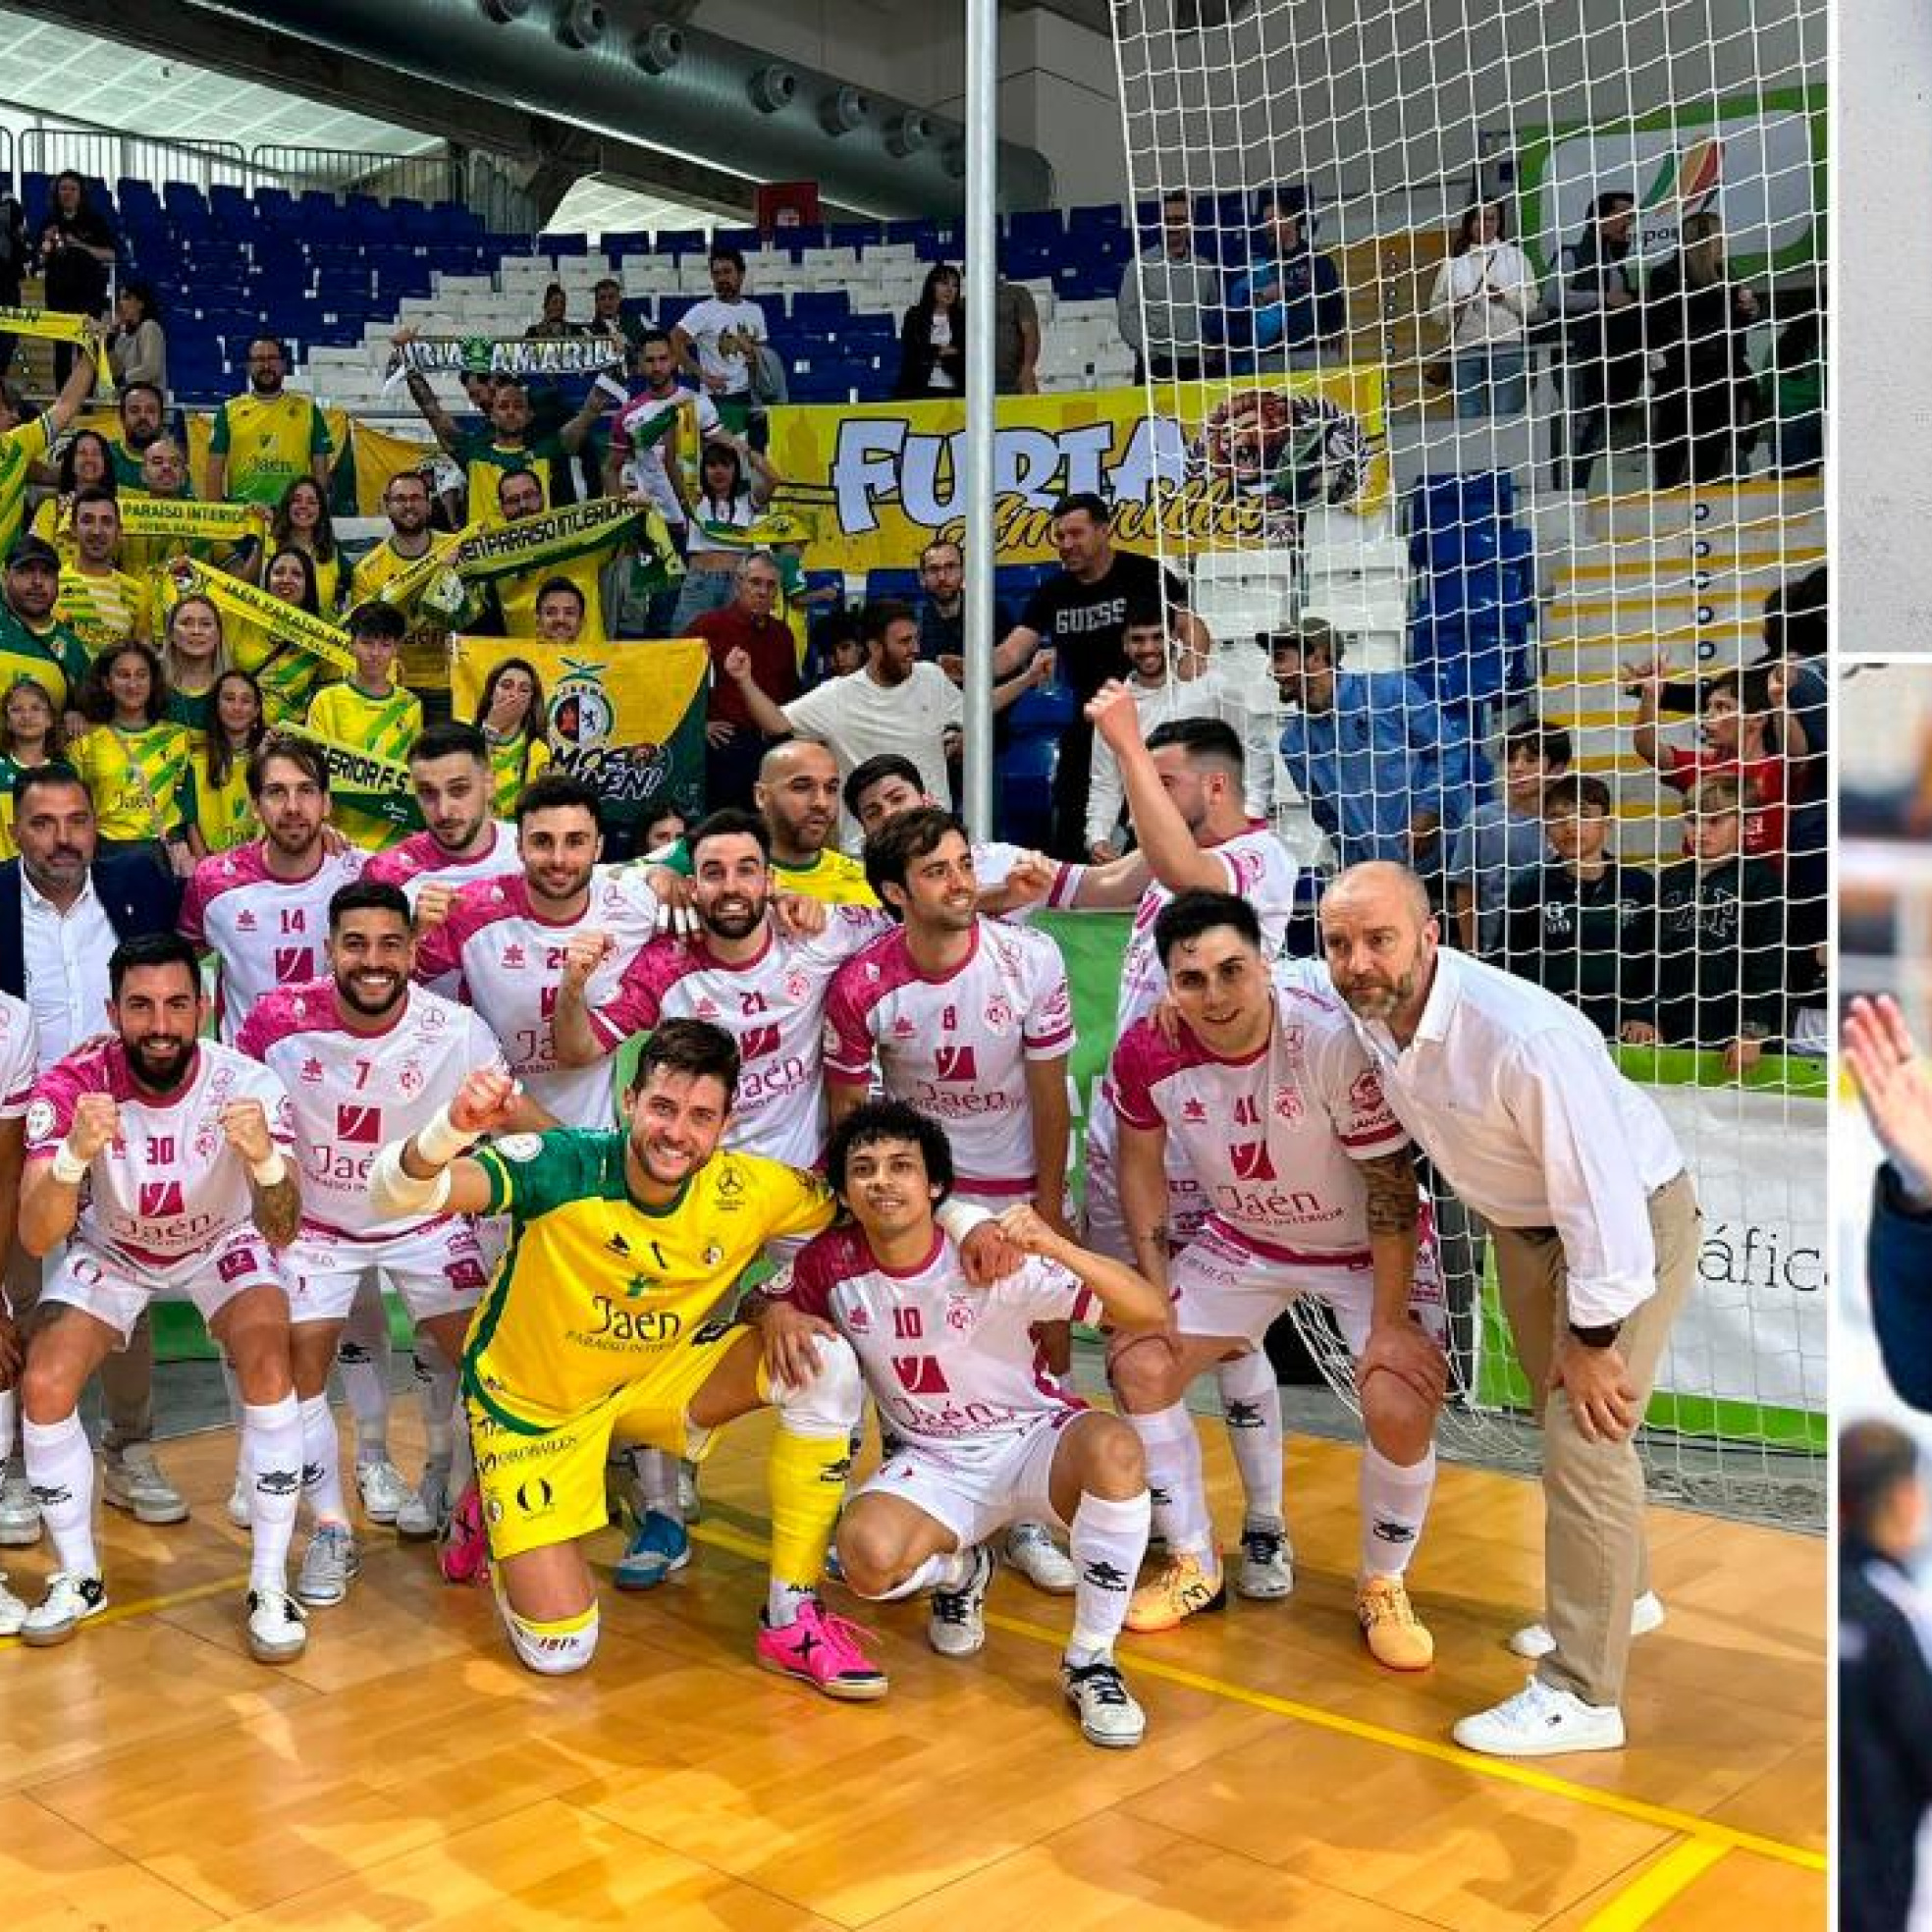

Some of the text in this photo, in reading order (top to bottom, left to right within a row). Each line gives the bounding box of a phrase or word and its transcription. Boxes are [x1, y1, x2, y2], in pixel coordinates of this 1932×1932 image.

[831, 414, 1194, 536] FURIA
[1056, 598, 1127, 634] GUESS
[281, 909, 306, 935] 14
[739, 992, 767, 1012] 21
[943, 1004, 957, 1031] 8
[516, 1029, 557, 1062] Ja
[355, 1059, 372, 1090] 7
[1232, 1095, 1261, 1126] 41
[146, 1137, 175, 1165] 30
[313, 1144, 373, 1179] Jaé
[1216, 1182, 1320, 1213] Jaén
[1697, 1224, 1827, 1292] áfic
[592, 1295, 680, 1341] Jaén
[892, 1307, 923, 1340] 10
